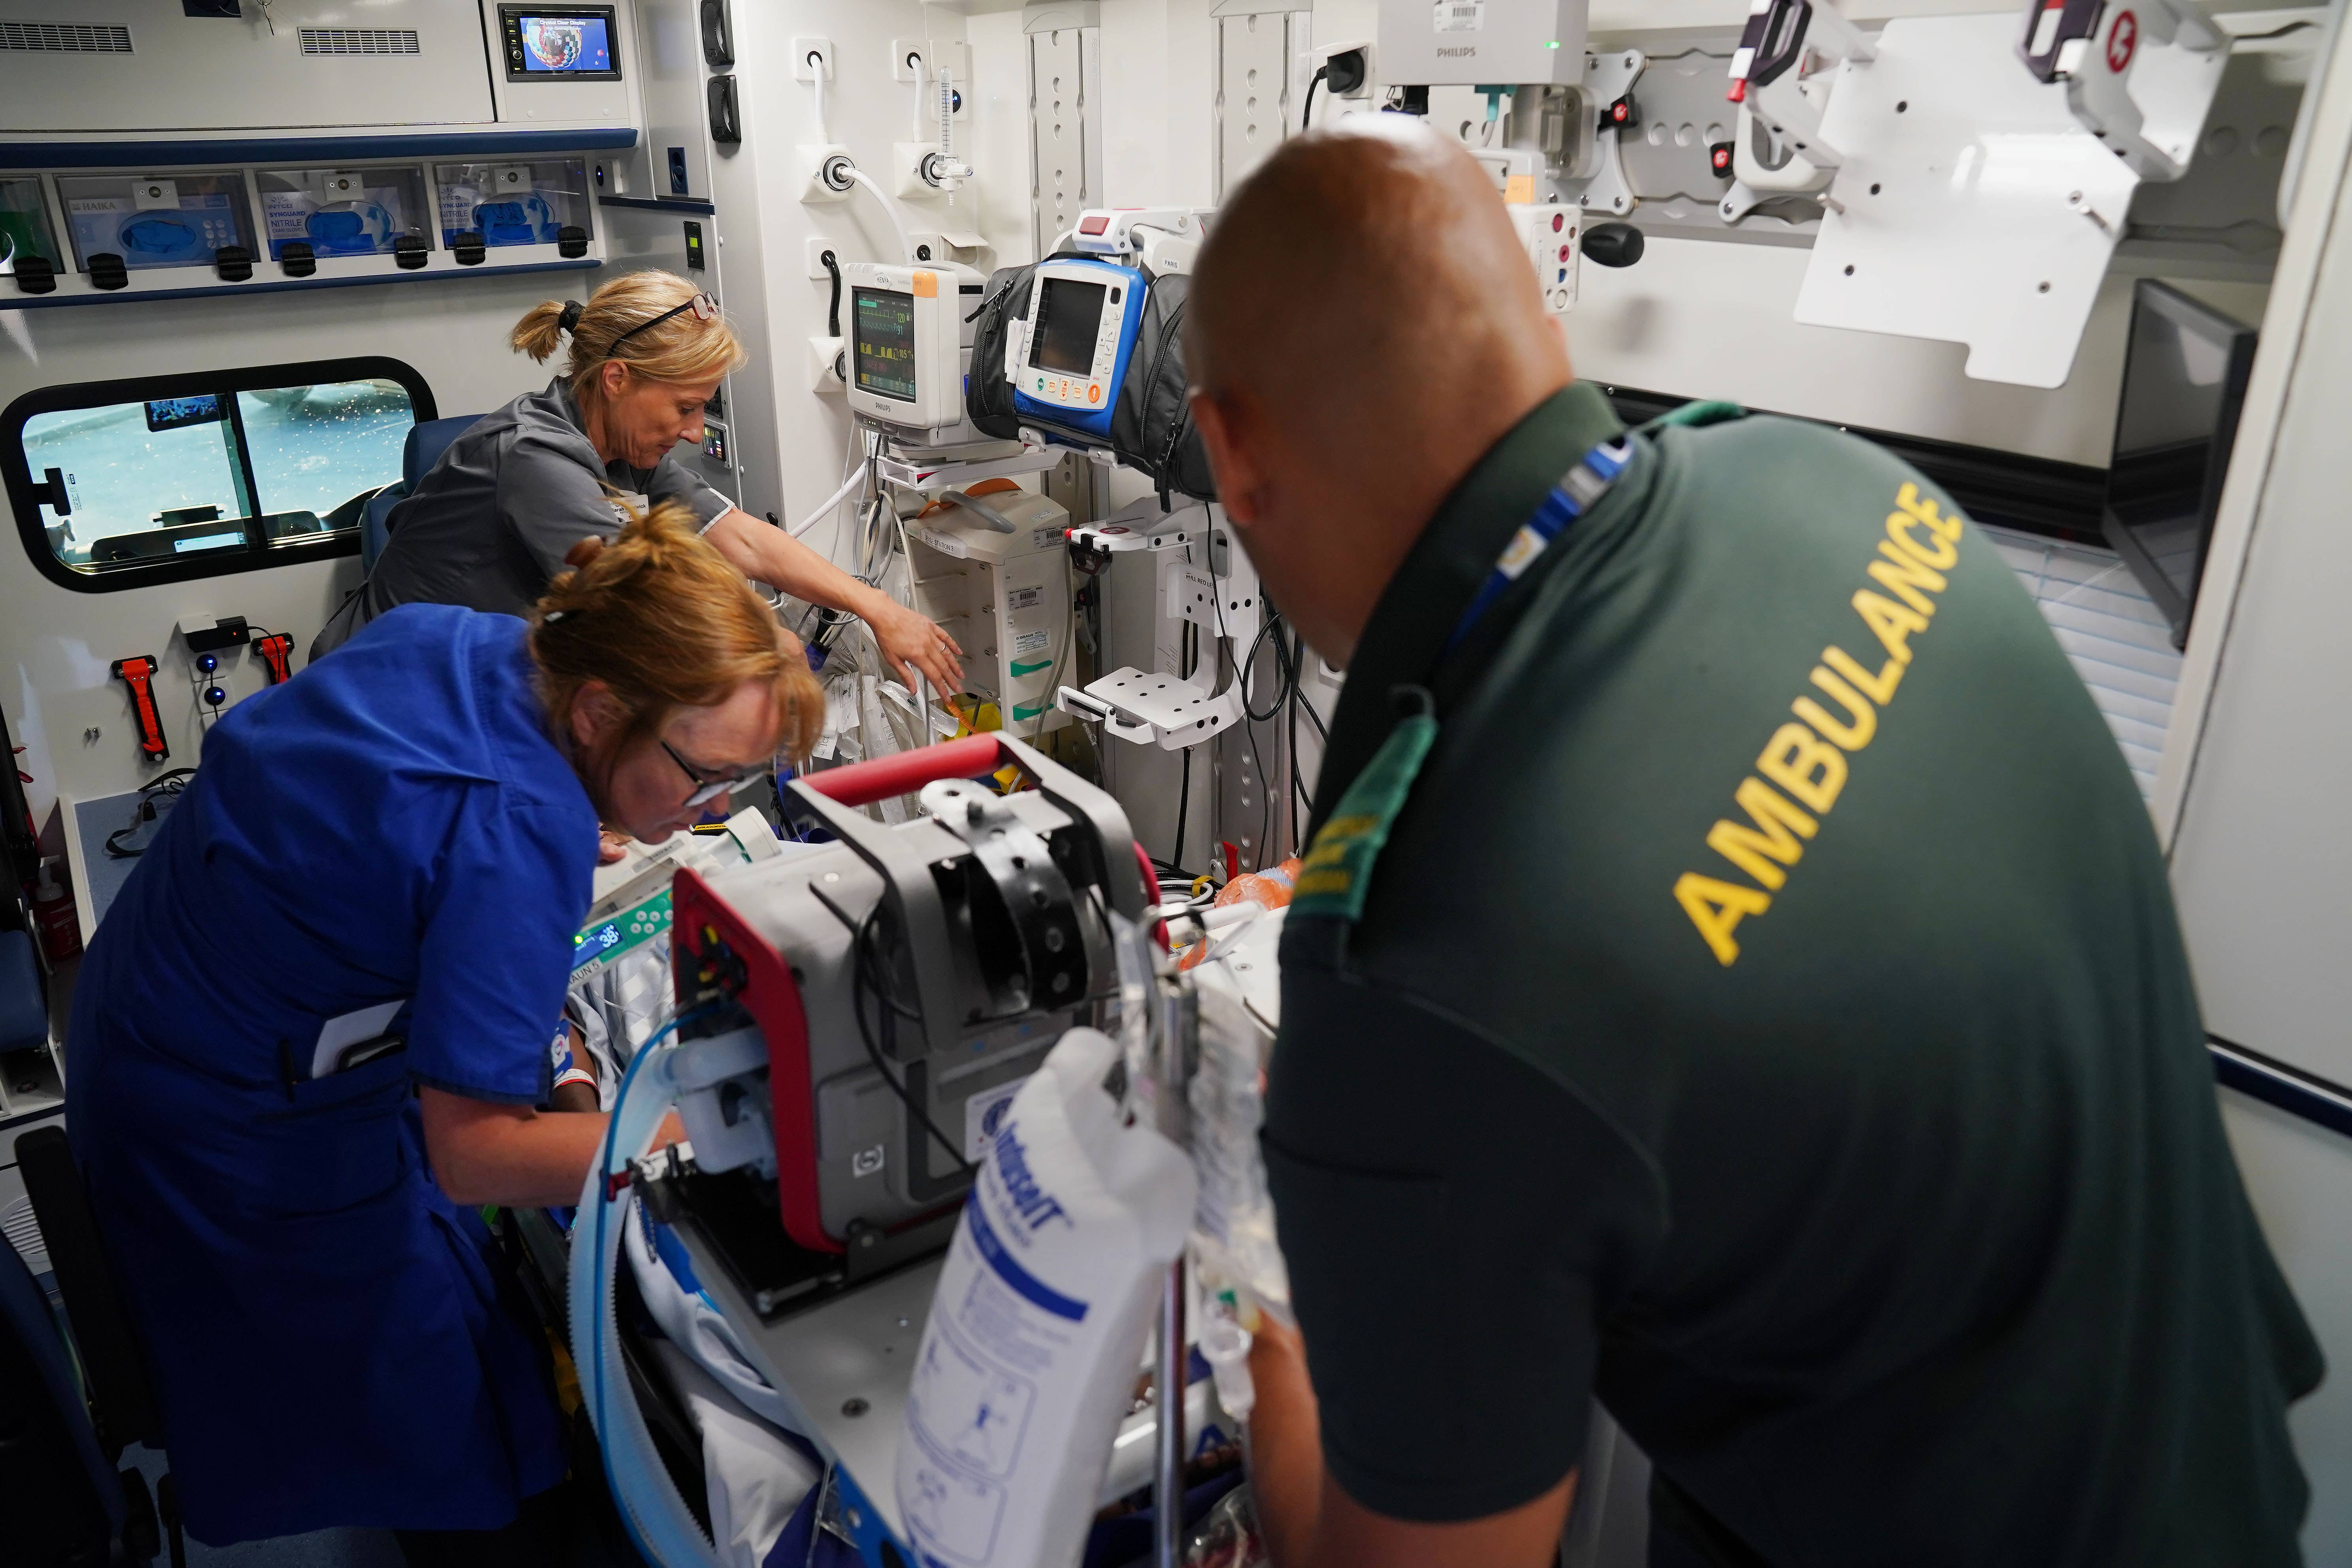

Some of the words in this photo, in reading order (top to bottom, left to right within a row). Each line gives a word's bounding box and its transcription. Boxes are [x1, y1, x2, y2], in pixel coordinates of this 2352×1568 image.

[1437, 46, 1476, 58] PHILIPS
[83, 202, 116, 211] HAIKA
[1164, 260, 1178, 269] PARIS
[897, 325, 903, 335] 91
[875, 402, 891, 412] PHILIPS
[934, 539, 950, 550] STATION
[1672, 481, 1965, 967] AMBULANCE
